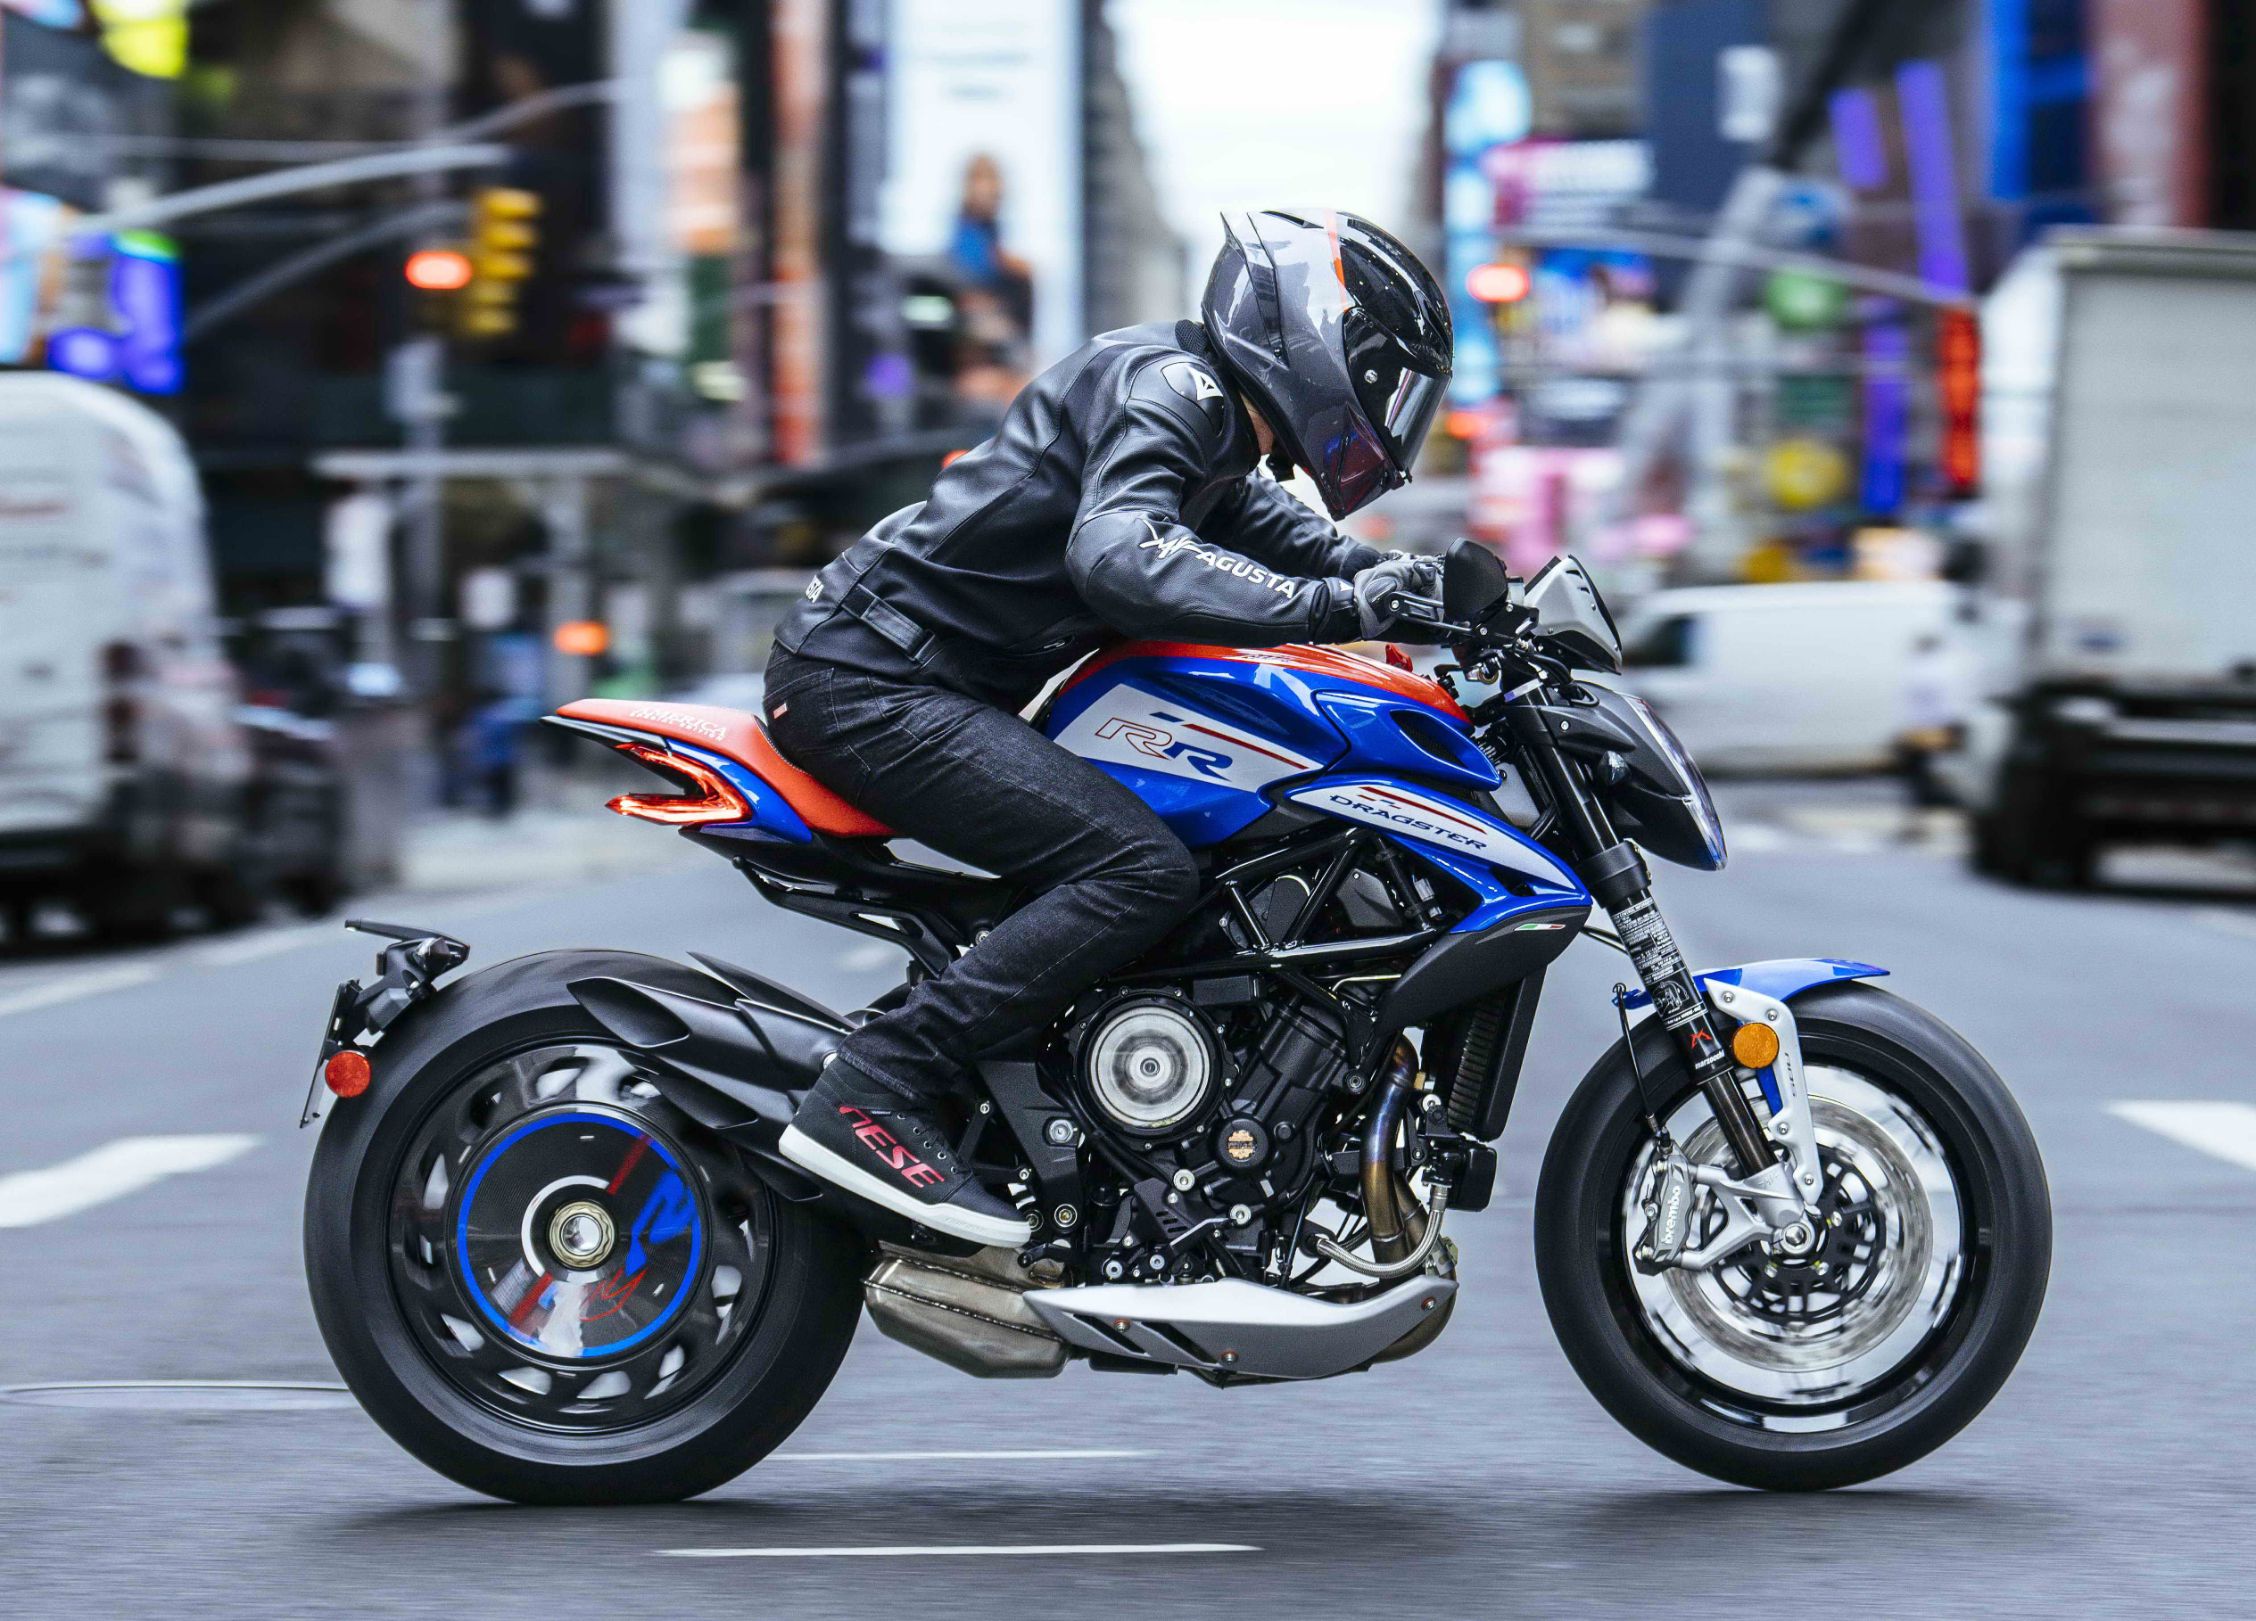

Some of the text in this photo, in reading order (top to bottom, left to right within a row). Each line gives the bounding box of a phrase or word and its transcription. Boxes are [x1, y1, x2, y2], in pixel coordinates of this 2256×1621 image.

[1195, 550, 1296, 599] AGUSTA
[633, 707, 728, 736] AMERICA
[1095, 717, 1233, 782] RR
[1329, 794, 1488, 850] DRAGSTER
[1661, 1185, 1681, 1245] brembo
